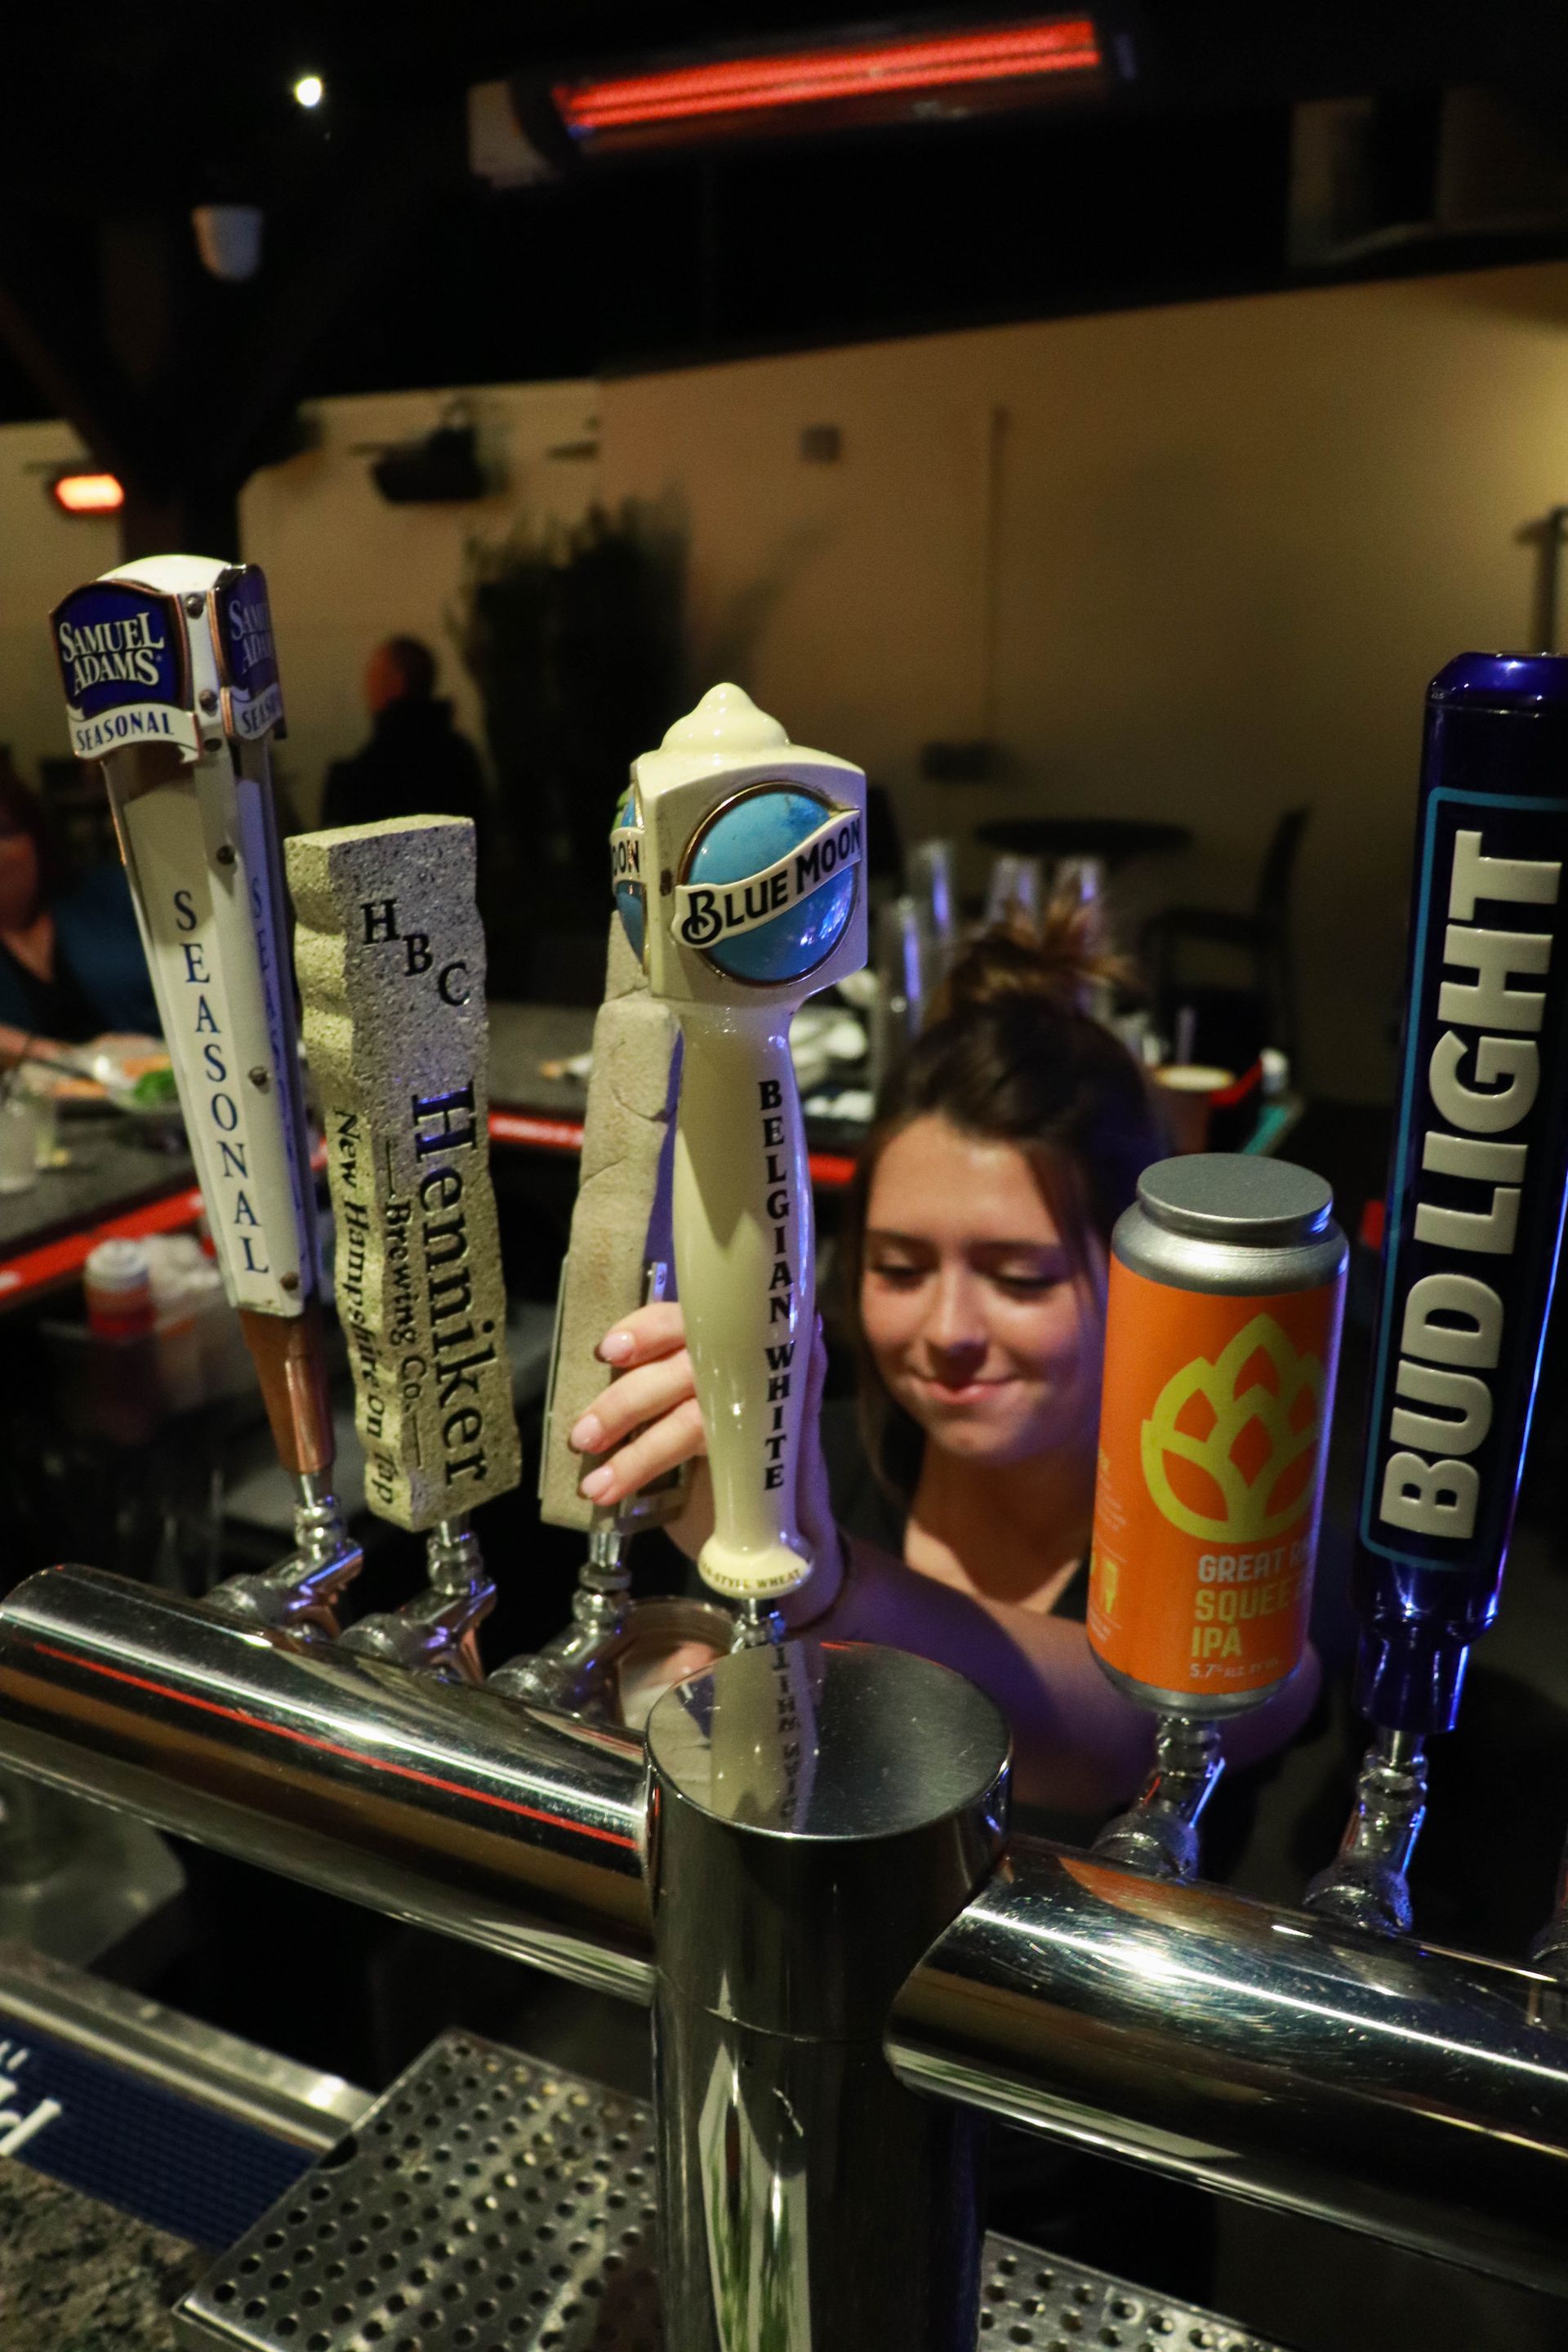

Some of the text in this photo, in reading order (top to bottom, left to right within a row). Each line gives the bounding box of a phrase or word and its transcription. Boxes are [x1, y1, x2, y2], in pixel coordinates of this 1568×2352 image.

[60, 612, 164, 662] SAMUEL
[74, 648, 160, 696] ADAMS
[76, 712, 174, 751] SEASONAL
[681, 818, 862, 945] BLUE MOON
[174, 891, 269, 1274] SEASONAL
[1379, 829, 1562, 1539] BUD LIGHT
[333, 1109, 399, 1504] New Hampshire on Tap
[385, 1200, 419, 1347] Brewing
[412, 1080, 497, 1486] Henniker
[758, 1080, 796, 1491] BELGIAN WHITE
[1198, 1547, 1285, 1583] GREAT
[1191, 1626, 1242, 1659] IPA
